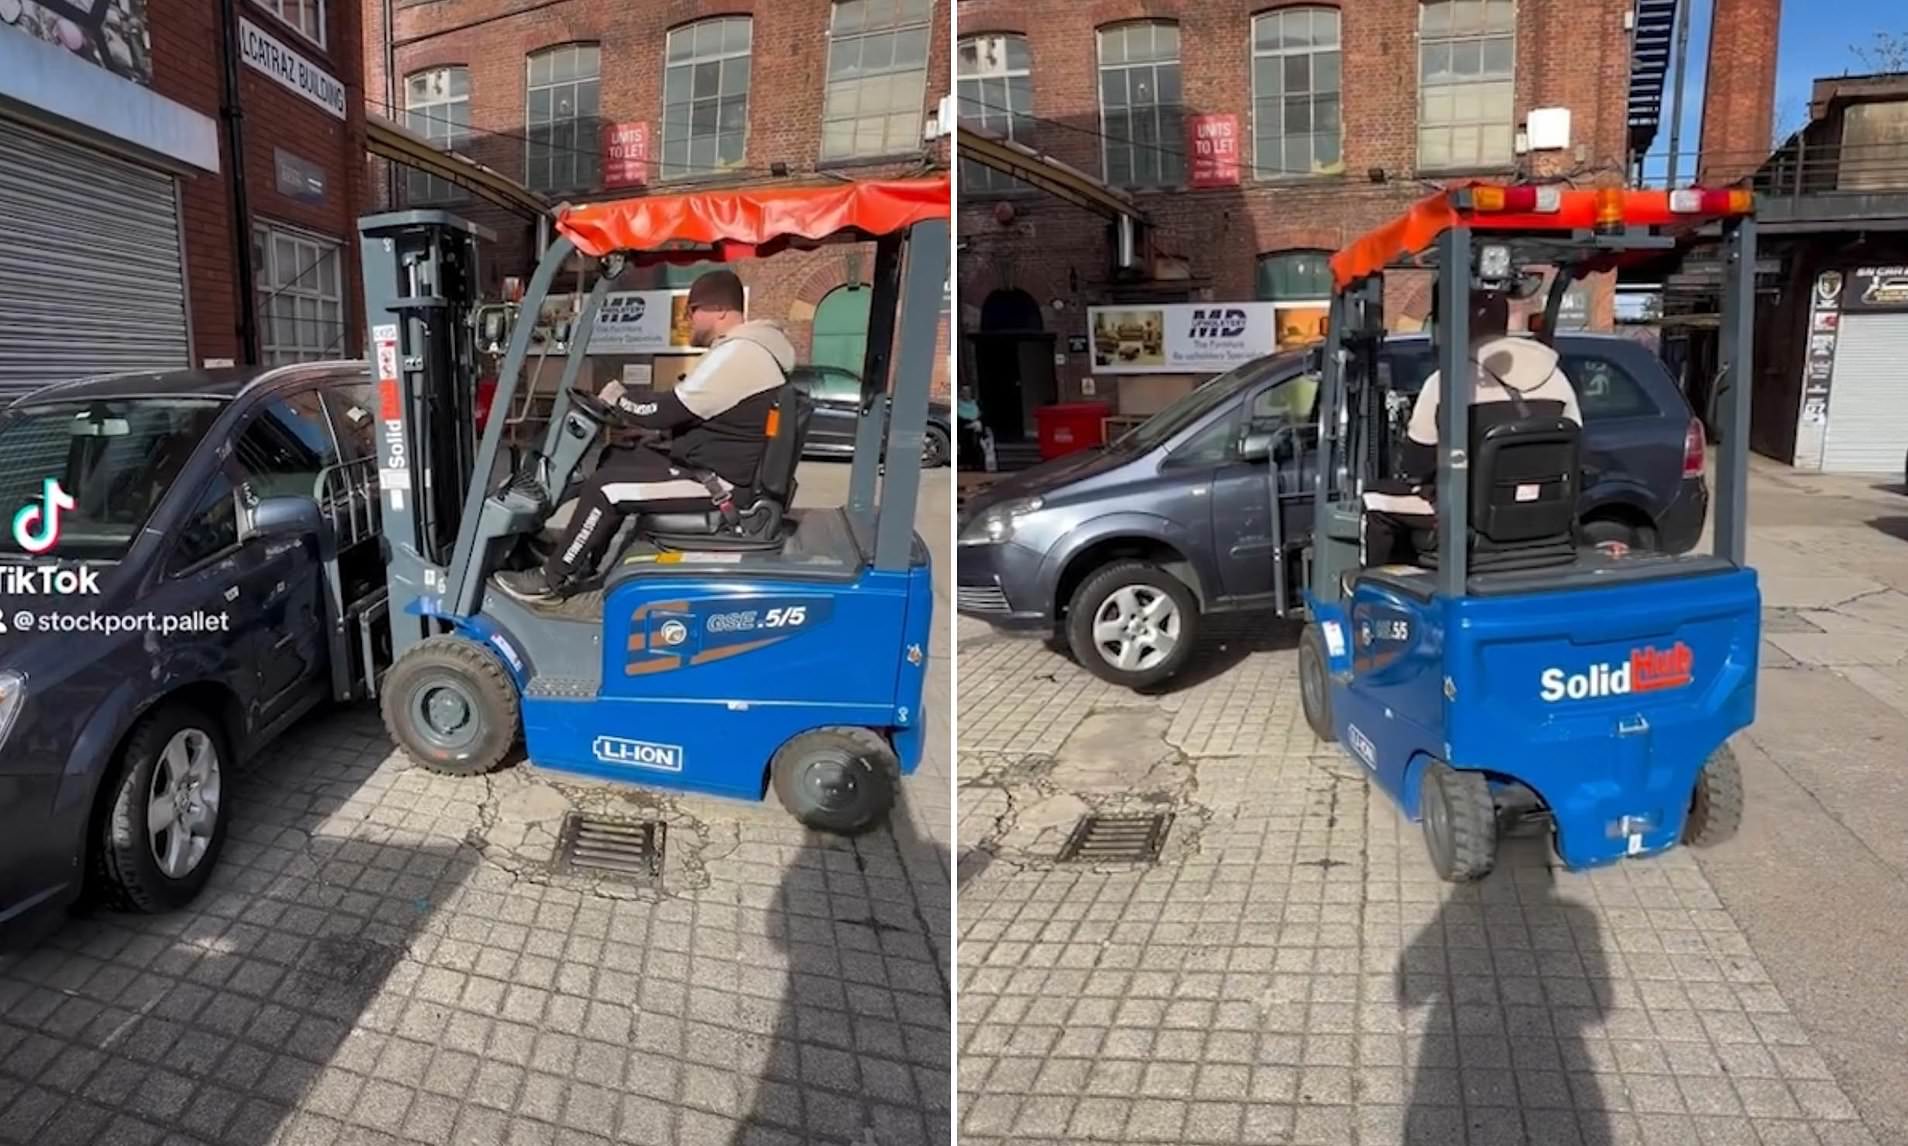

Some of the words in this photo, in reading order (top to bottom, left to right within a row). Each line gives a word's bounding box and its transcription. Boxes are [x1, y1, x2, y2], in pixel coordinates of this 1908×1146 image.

[241, 26, 296, 83] LCATRAZ
[299, 63, 344, 112] BUILDING
[611, 130, 642, 144] UNITS
[1197, 122, 1232, 138] UNITS
[609, 146, 622, 158] TO
[624, 144, 643, 158] LET
[1195, 140, 1211, 154] TO
[1213, 139, 1233, 154] LET
[1188, 309, 1247, 338] MD
[385, 419, 405, 469] Solid
[604, 740, 674, 766] LI-ION
